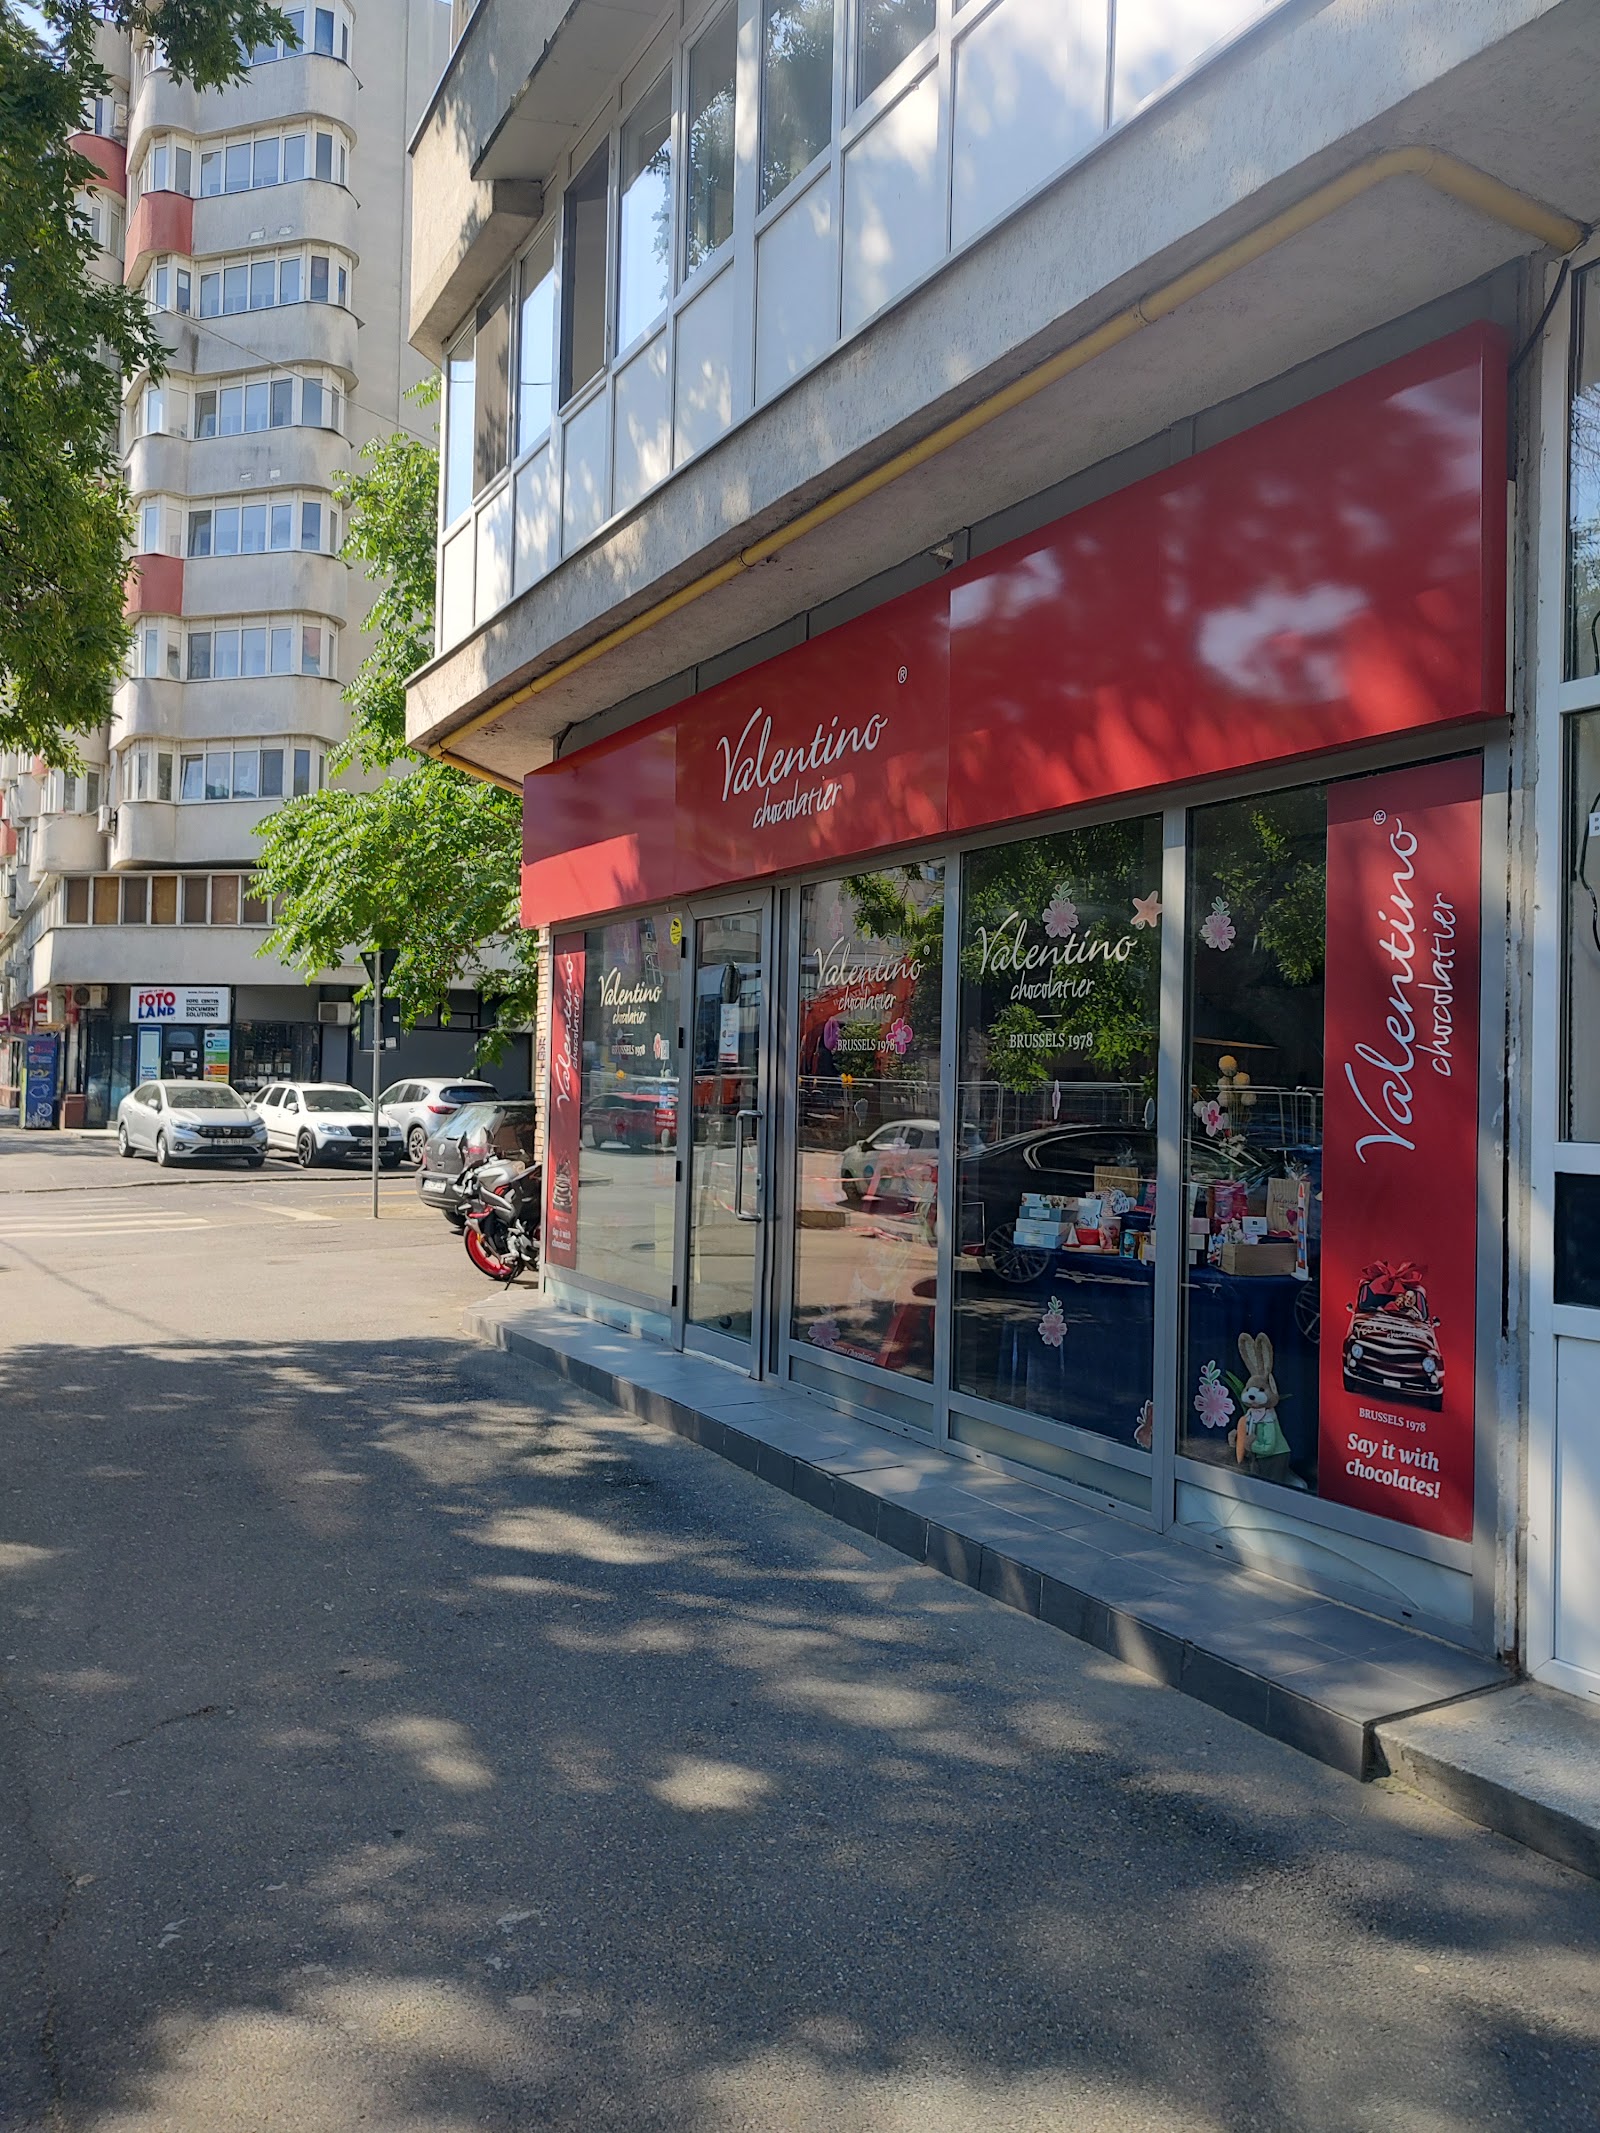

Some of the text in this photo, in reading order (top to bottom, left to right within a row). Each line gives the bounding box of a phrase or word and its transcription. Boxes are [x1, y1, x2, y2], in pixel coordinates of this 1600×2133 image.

[717, 706, 889, 801] Valentino
[752, 775, 842, 829] chocolatier
[975, 911, 1138, 974] Valentino
[813, 936, 925, 989] Valentino
[139, 991, 176, 1007] FOTO
[598, 967, 662, 1007] Valentino
[838, 986, 896, 1010] chocolatier
[1010, 970, 1095, 1000] chocolatier
[1344, 818, 1418, 1163] Valentino
[1415, 892, 1456, 1077] chocolatier
[138, 1006, 175, 1019] LAND
[837, 1039, 895, 1053] BRUSSELS 1978
[1009, 1032, 1093, 1049] BRUSSELS 1978
[1359, 1407, 1426, 1433] BRUSSELS 1978
[1347, 1433, 1440, 1472] Say it with
[1345, 1458, 1441, 1499] chocolates!
